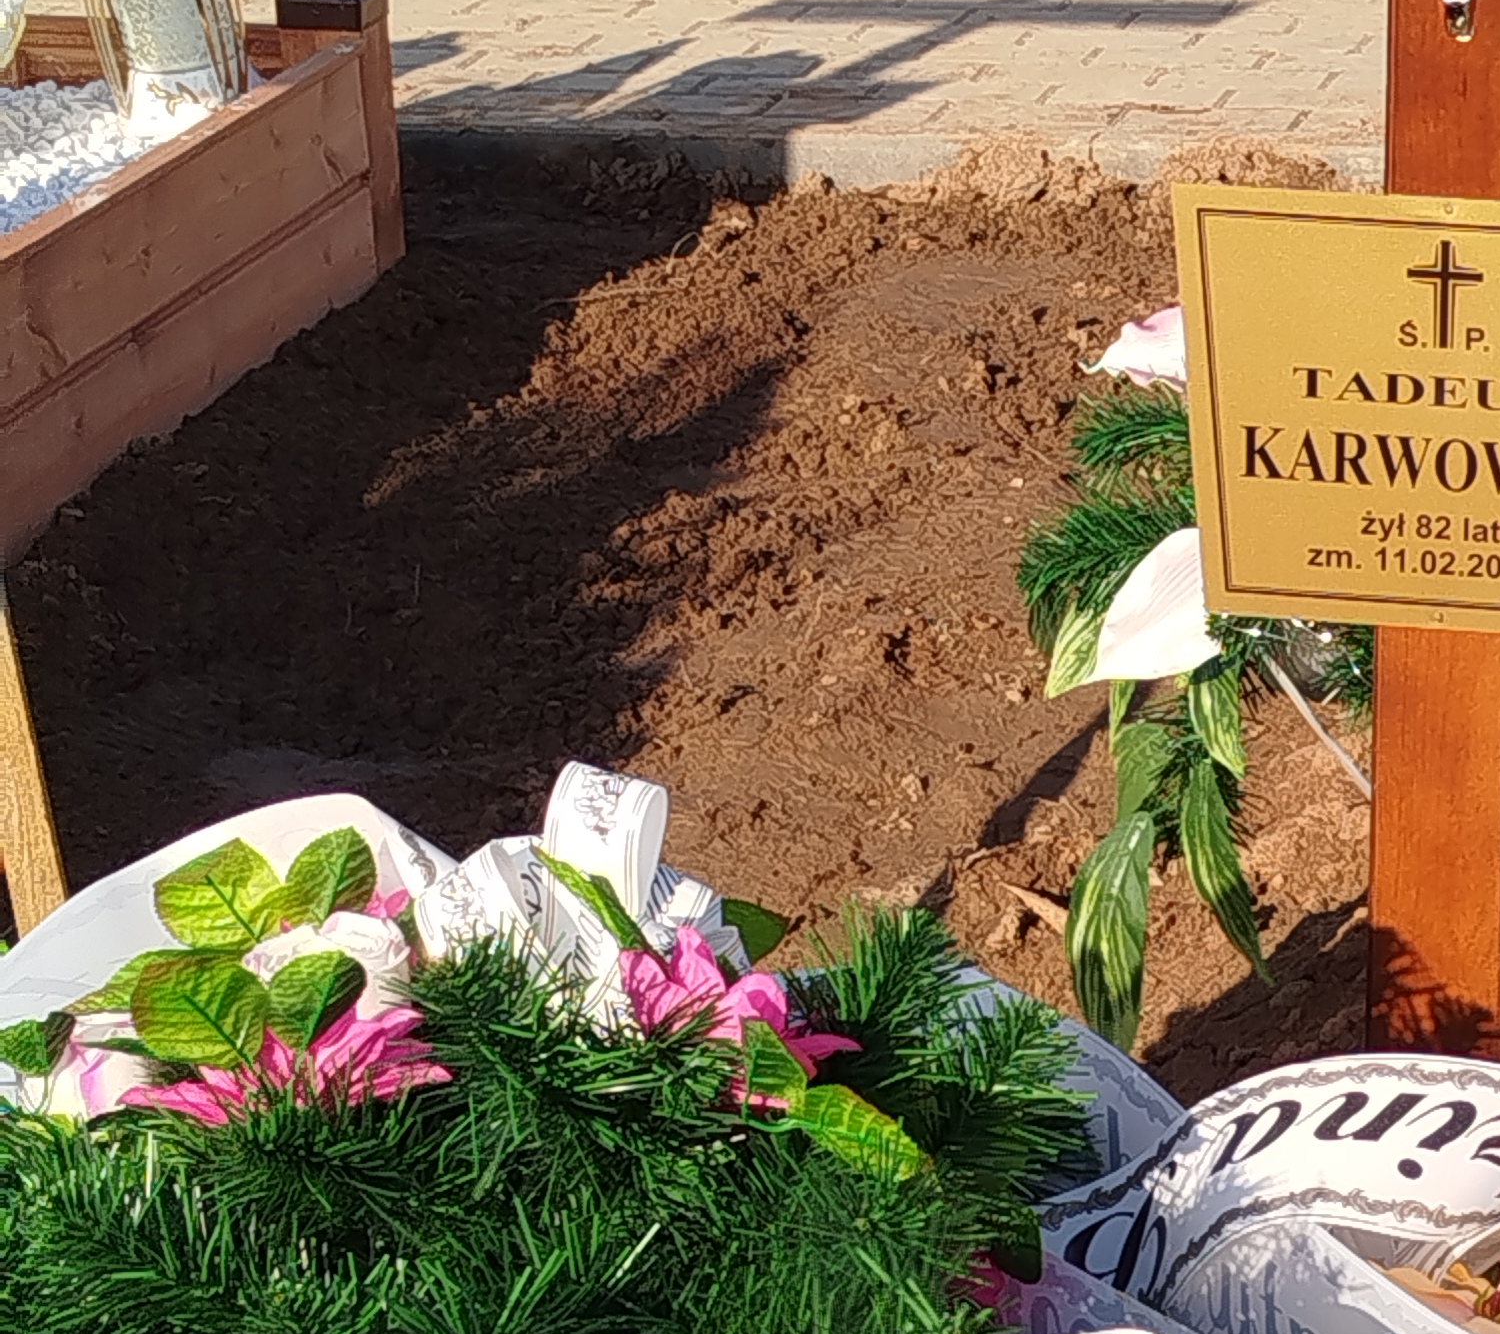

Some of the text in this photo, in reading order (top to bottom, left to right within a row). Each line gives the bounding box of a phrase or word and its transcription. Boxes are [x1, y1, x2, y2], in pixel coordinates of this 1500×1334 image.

[1397, 320, 1490, 352] Ś. P.
[1361, 510, 1407, 538] żył
[1416, 515, 1451, 541] 82
[1307, 547, 1361, 570] zm.
